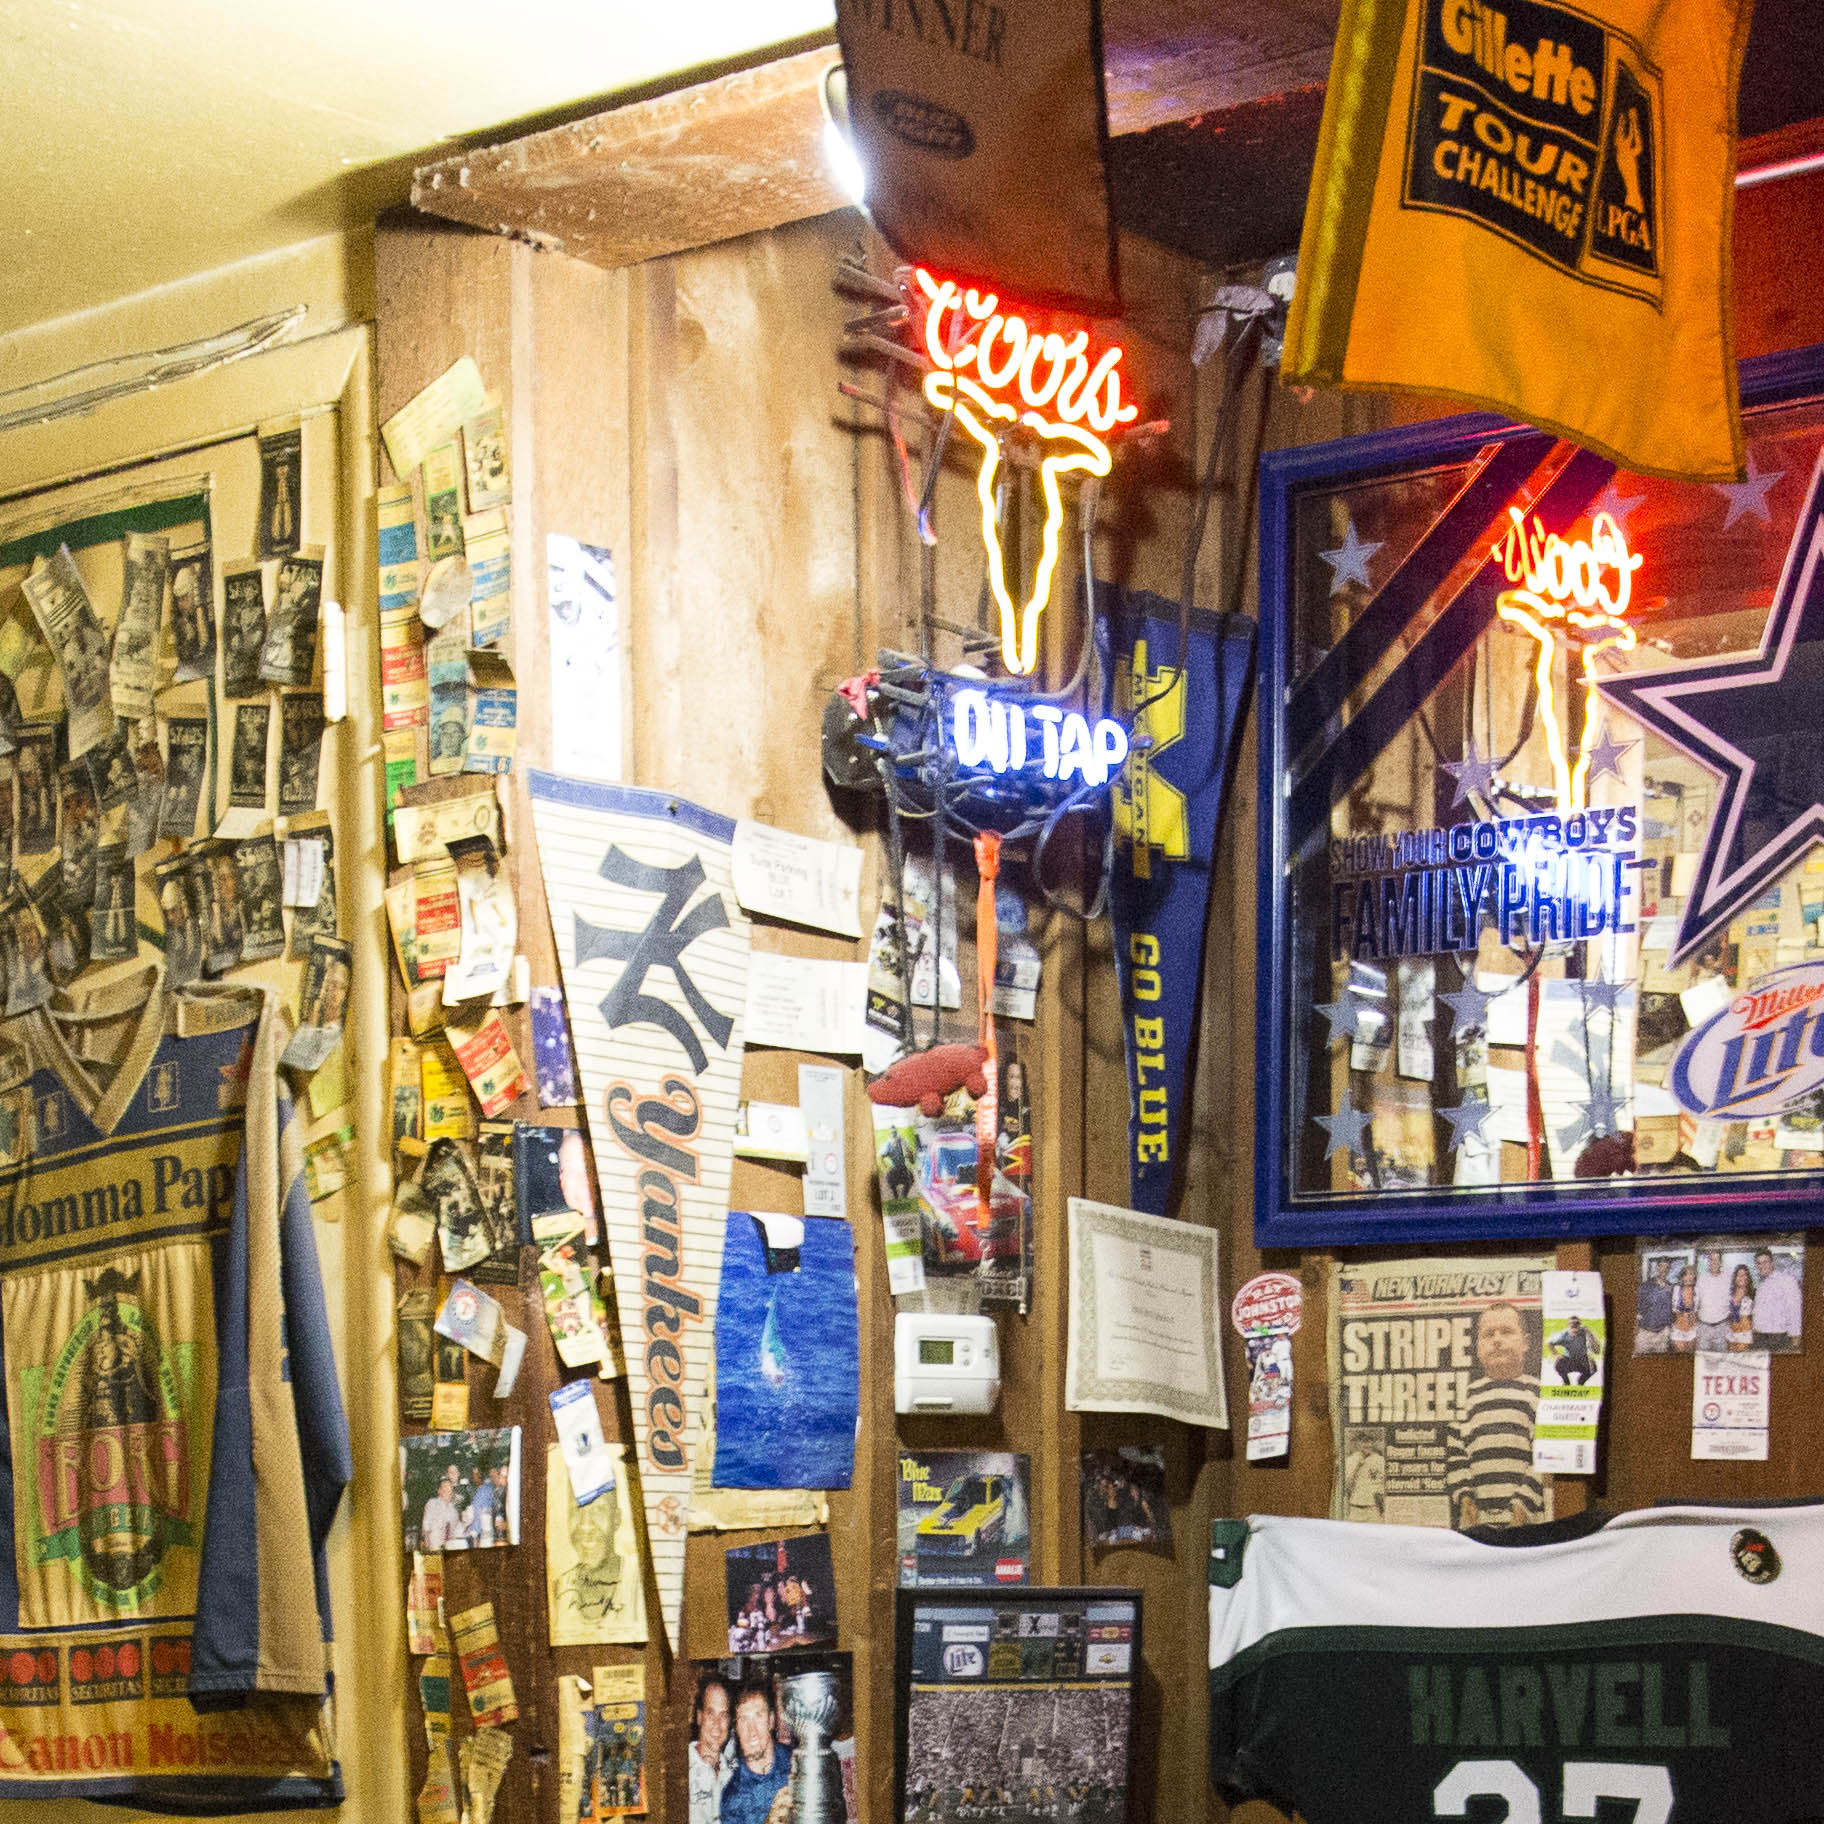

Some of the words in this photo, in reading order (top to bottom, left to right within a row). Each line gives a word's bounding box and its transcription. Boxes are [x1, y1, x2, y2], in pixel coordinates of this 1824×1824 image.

[1440, 0, 1597, 116] Gillette
[1439, 91, 1589, 194] TOUR
[1433, 139, 1584, 240] CHALLENGE
[1031, 704, 1130, 788] TAP
[1327, 837, 1388, 875] SHOW
[1392, 828, 1448, 868] YOUR
[1449, 805, 1638, 862] COWBOYS
[1332, 864, 1494, 962] FAMILY
[1497, 851, 1638, 946] PRIDE
[1130, 933, 1162, 1008] GO
[1132, 1018, 1168, 1164] BLUE
[150, 1155, 237, 1232] Pap
[601, 1072, 706, 1473] Yankees
[1372, 1275, 1415, 1300] NEW
[1413, 1273, 1461, 1299] YORK
[1463, 1271, 1512, 1296] POST
[1342, 1316, 1473, 1372] STRIPE
[1702, 1374, 1761, 1397] TEXAS
[1343, 1371, 1468, 1424] THREE!
[1409, 1660, 1733, 1749] HARVELL
